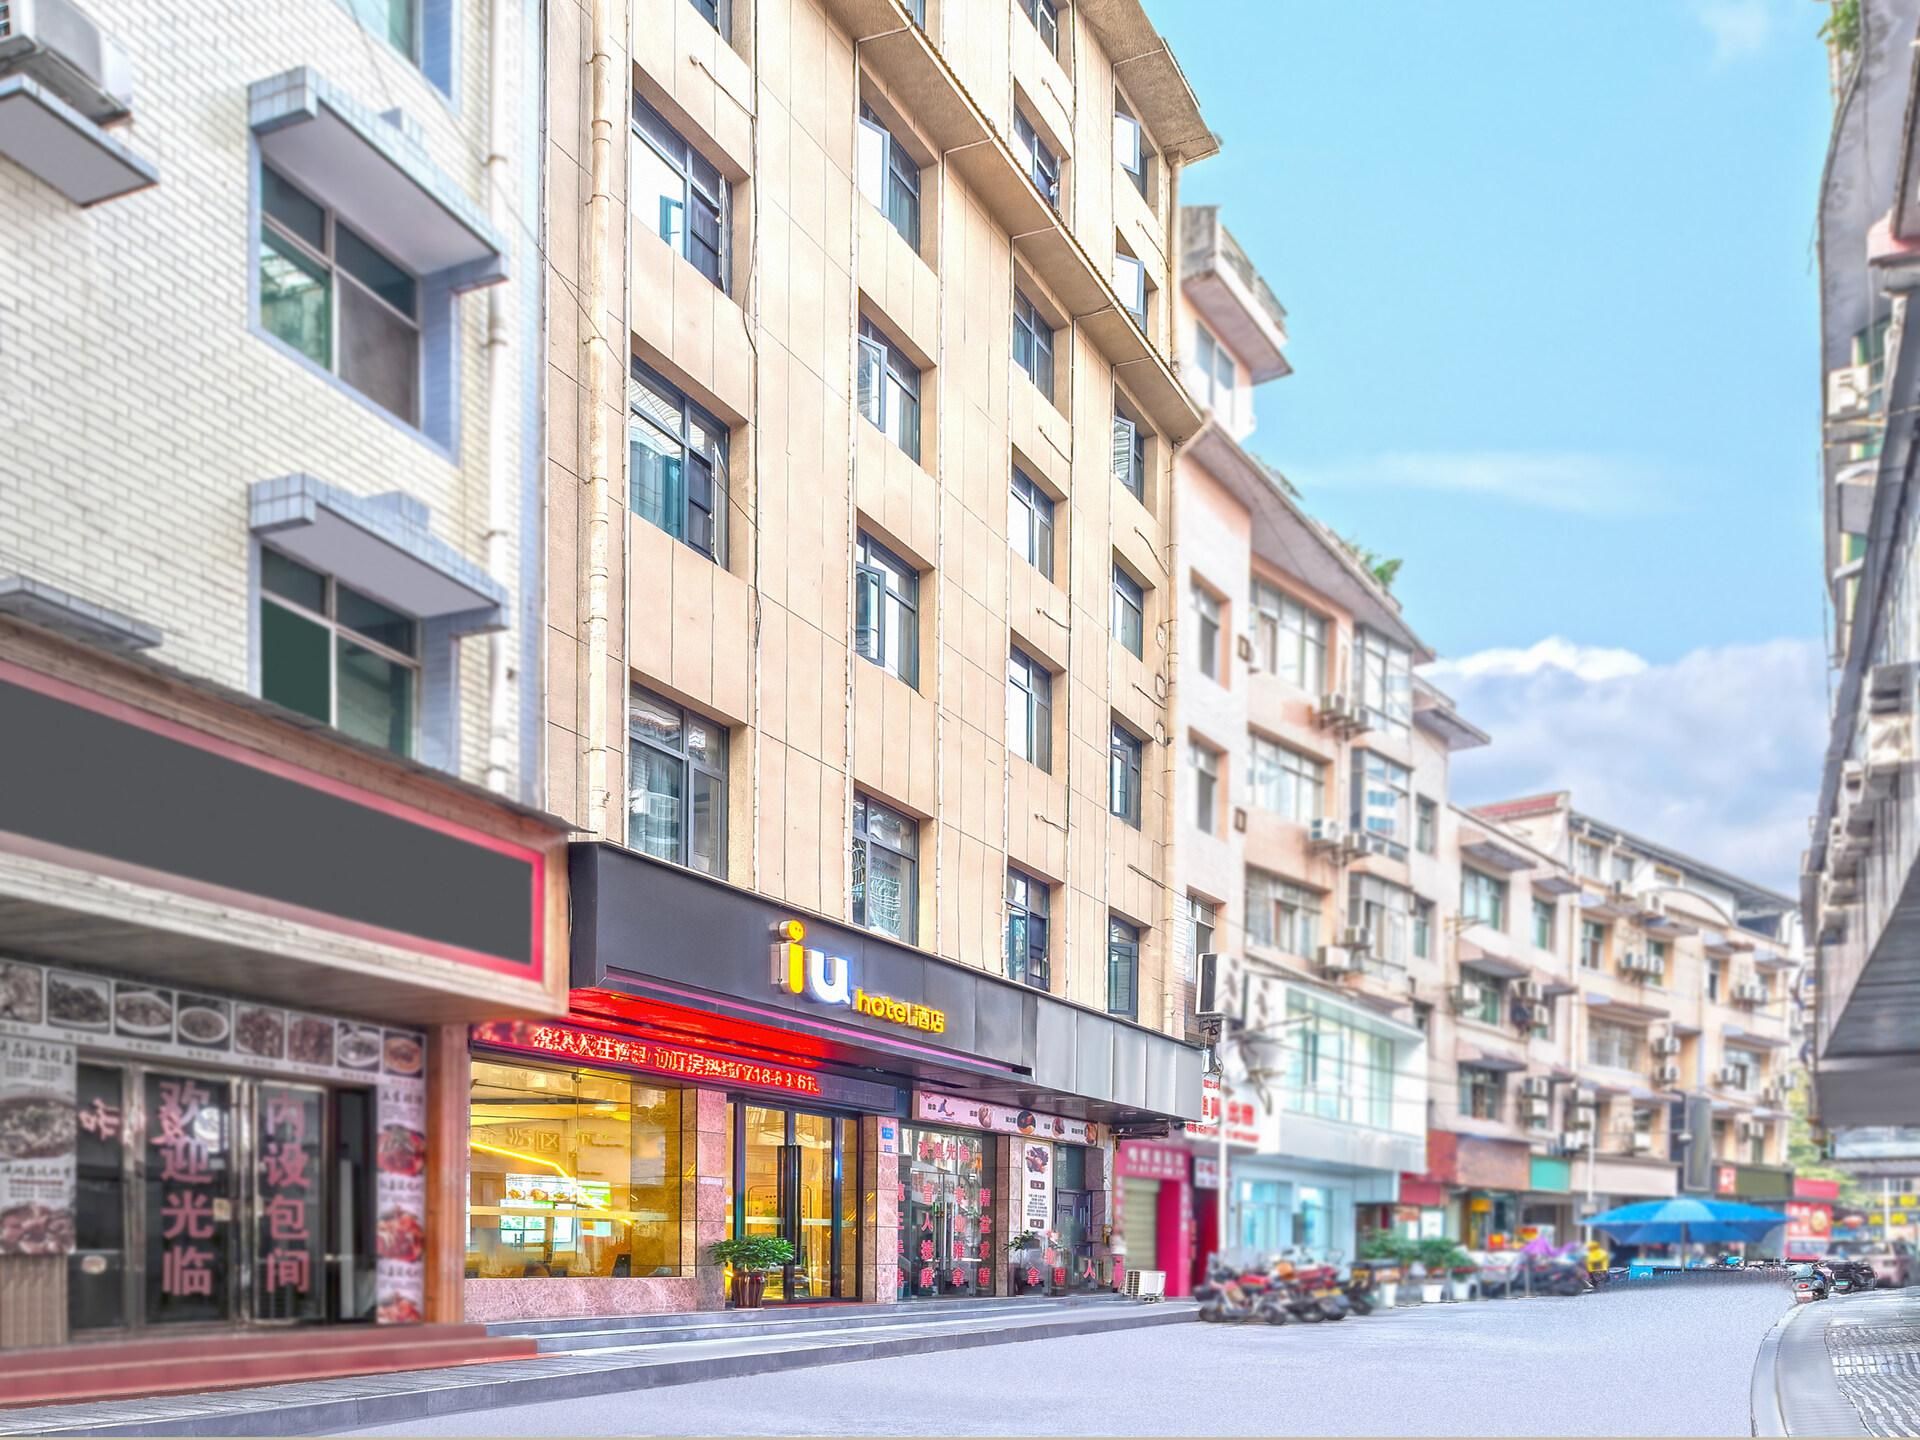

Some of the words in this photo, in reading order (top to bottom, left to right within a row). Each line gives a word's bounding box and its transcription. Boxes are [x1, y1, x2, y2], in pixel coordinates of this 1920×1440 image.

[854, 988, 913, 1026] hotel
[914, 1004, 945, 1034] 酒店
[160, 1080, 215, 1296] 欢迎光临
[265, 1093, 310, 1293] 内设包间
[918, 1140, 970, 1163] 欢迎光临
